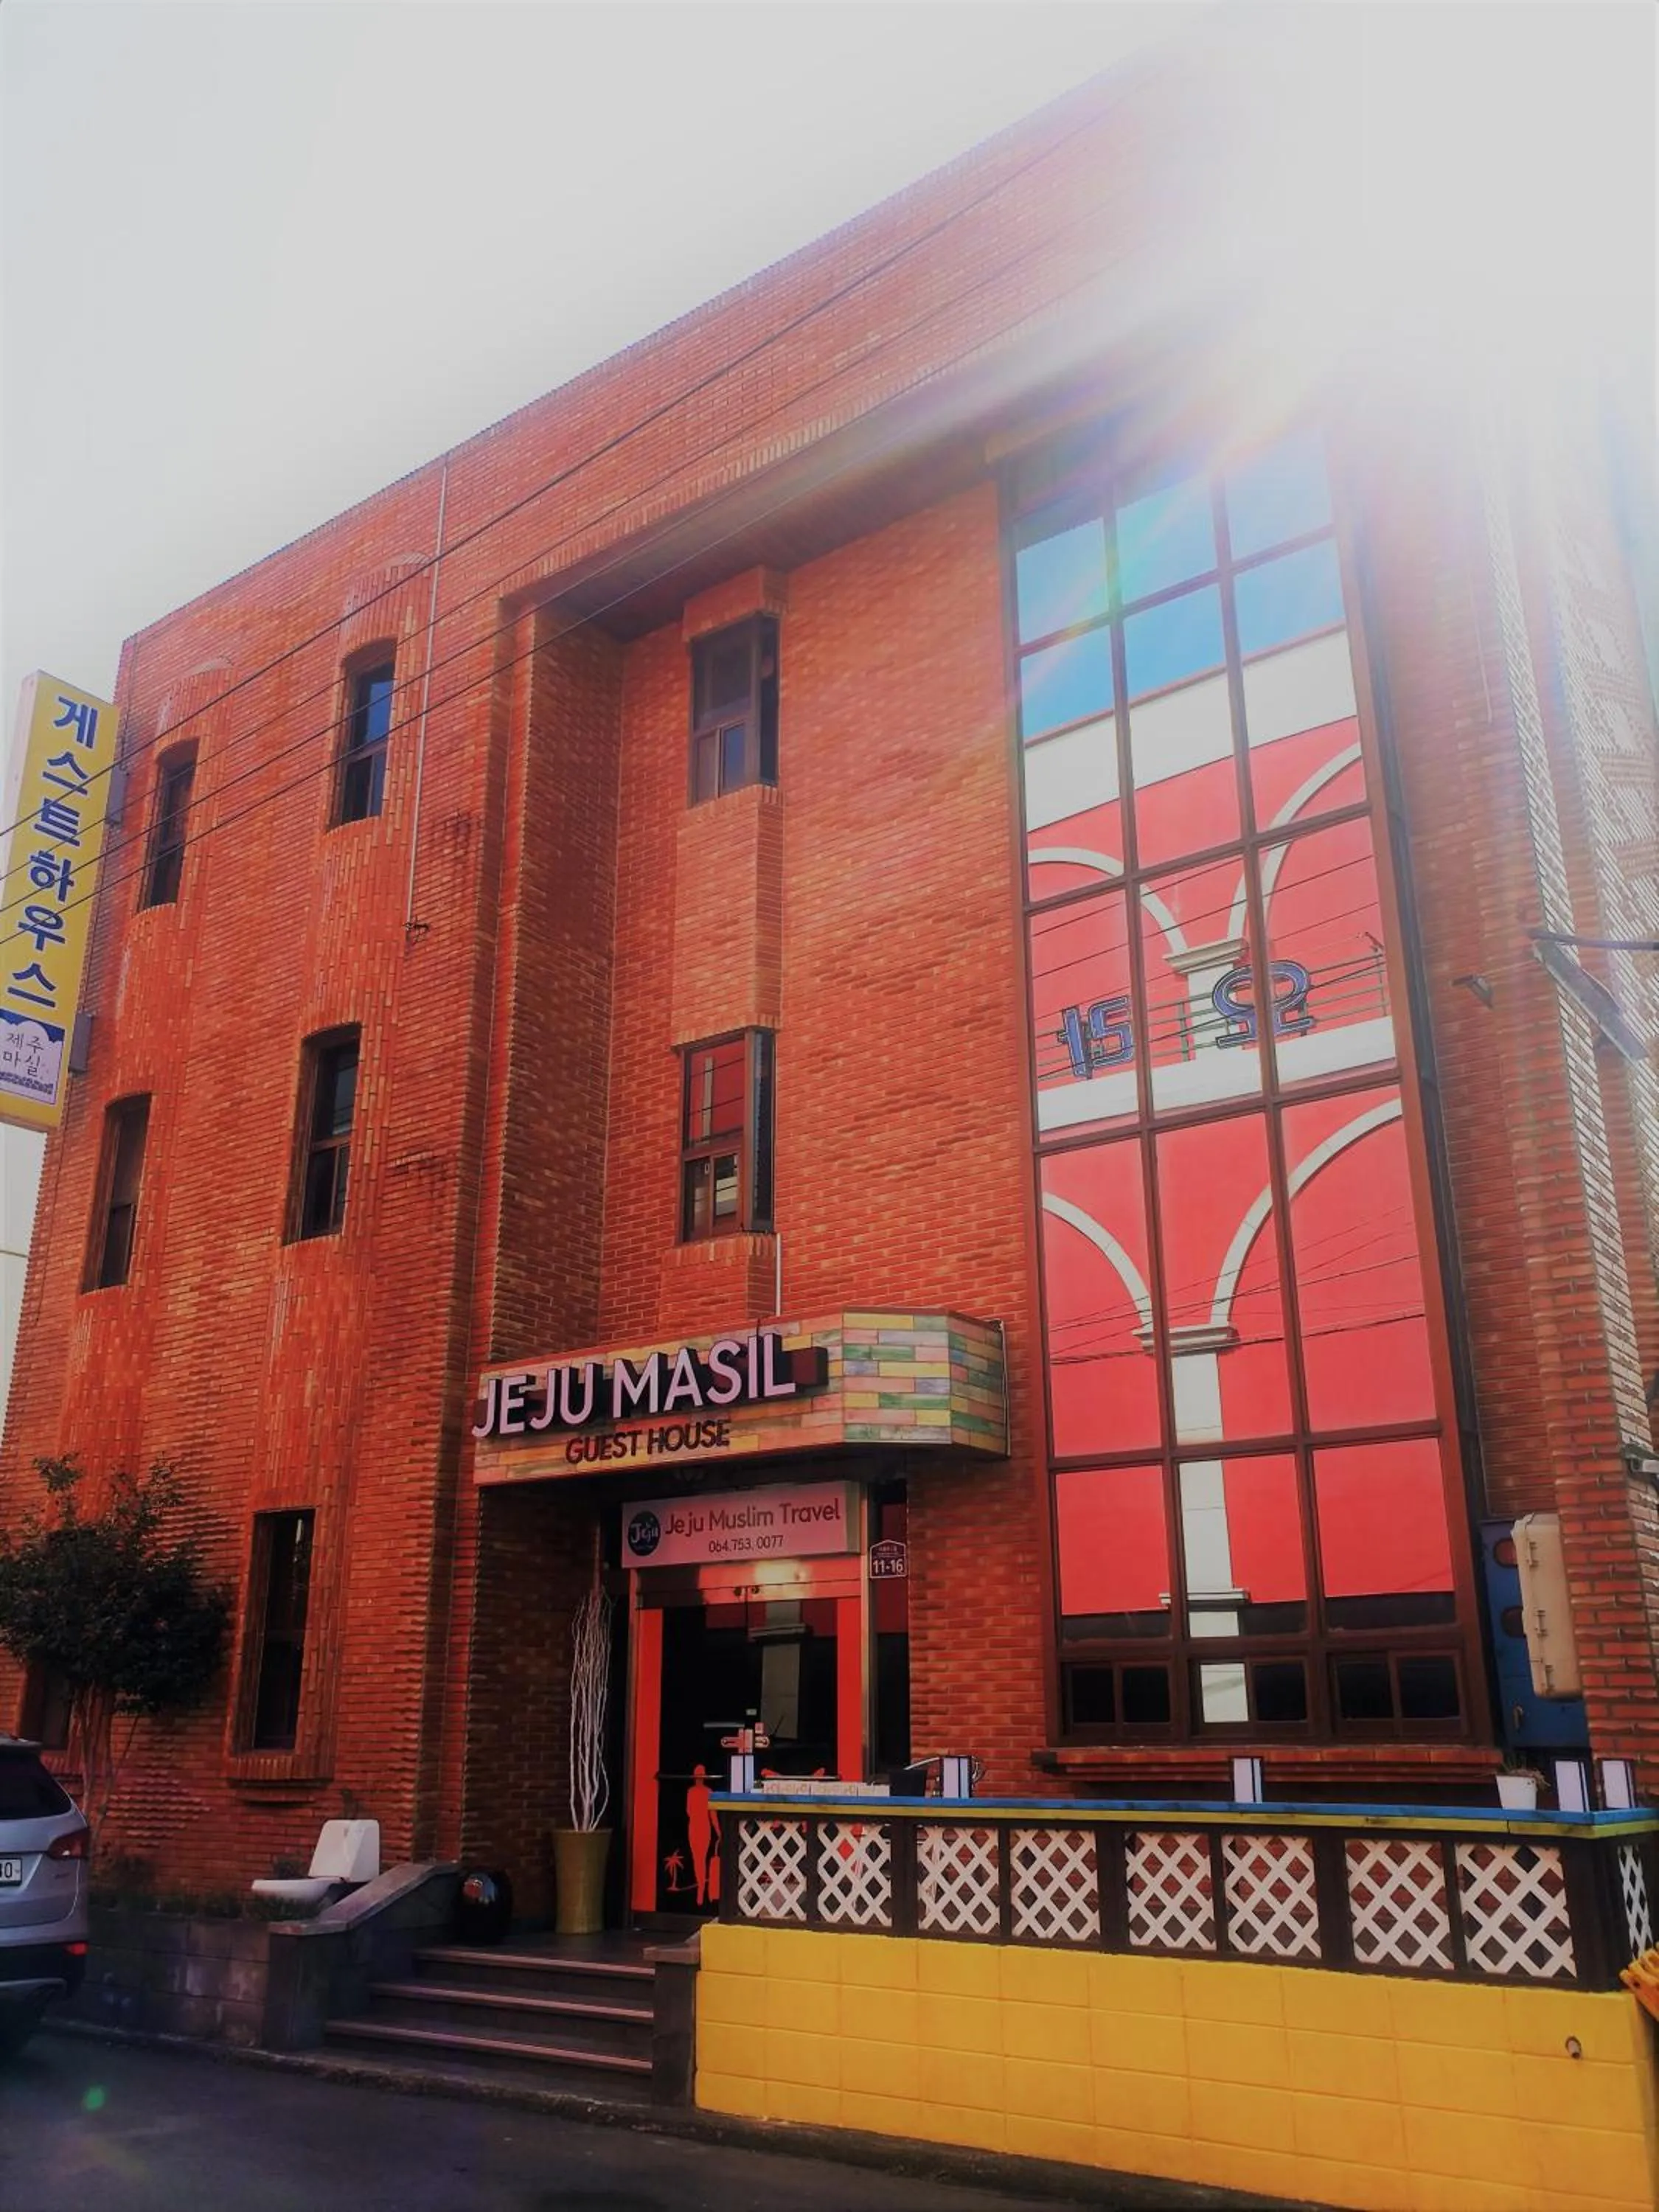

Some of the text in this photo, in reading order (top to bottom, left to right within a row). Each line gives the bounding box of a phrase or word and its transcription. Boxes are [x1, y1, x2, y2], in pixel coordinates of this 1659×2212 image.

[7, 695, 98, 1008] 게스트하우스
[5, 1032, 44, 1054] 제주
[3, 1051, 41, 1077] 마실
[472, 1333, 796, 1438] JEJU MASIL
[566, 1418, 731, 1464] GUEST HOUSE
[665, 1498, 841, 1537] Jeju Muslim Travel
[872, 1558, 904, 1575] 11-16
